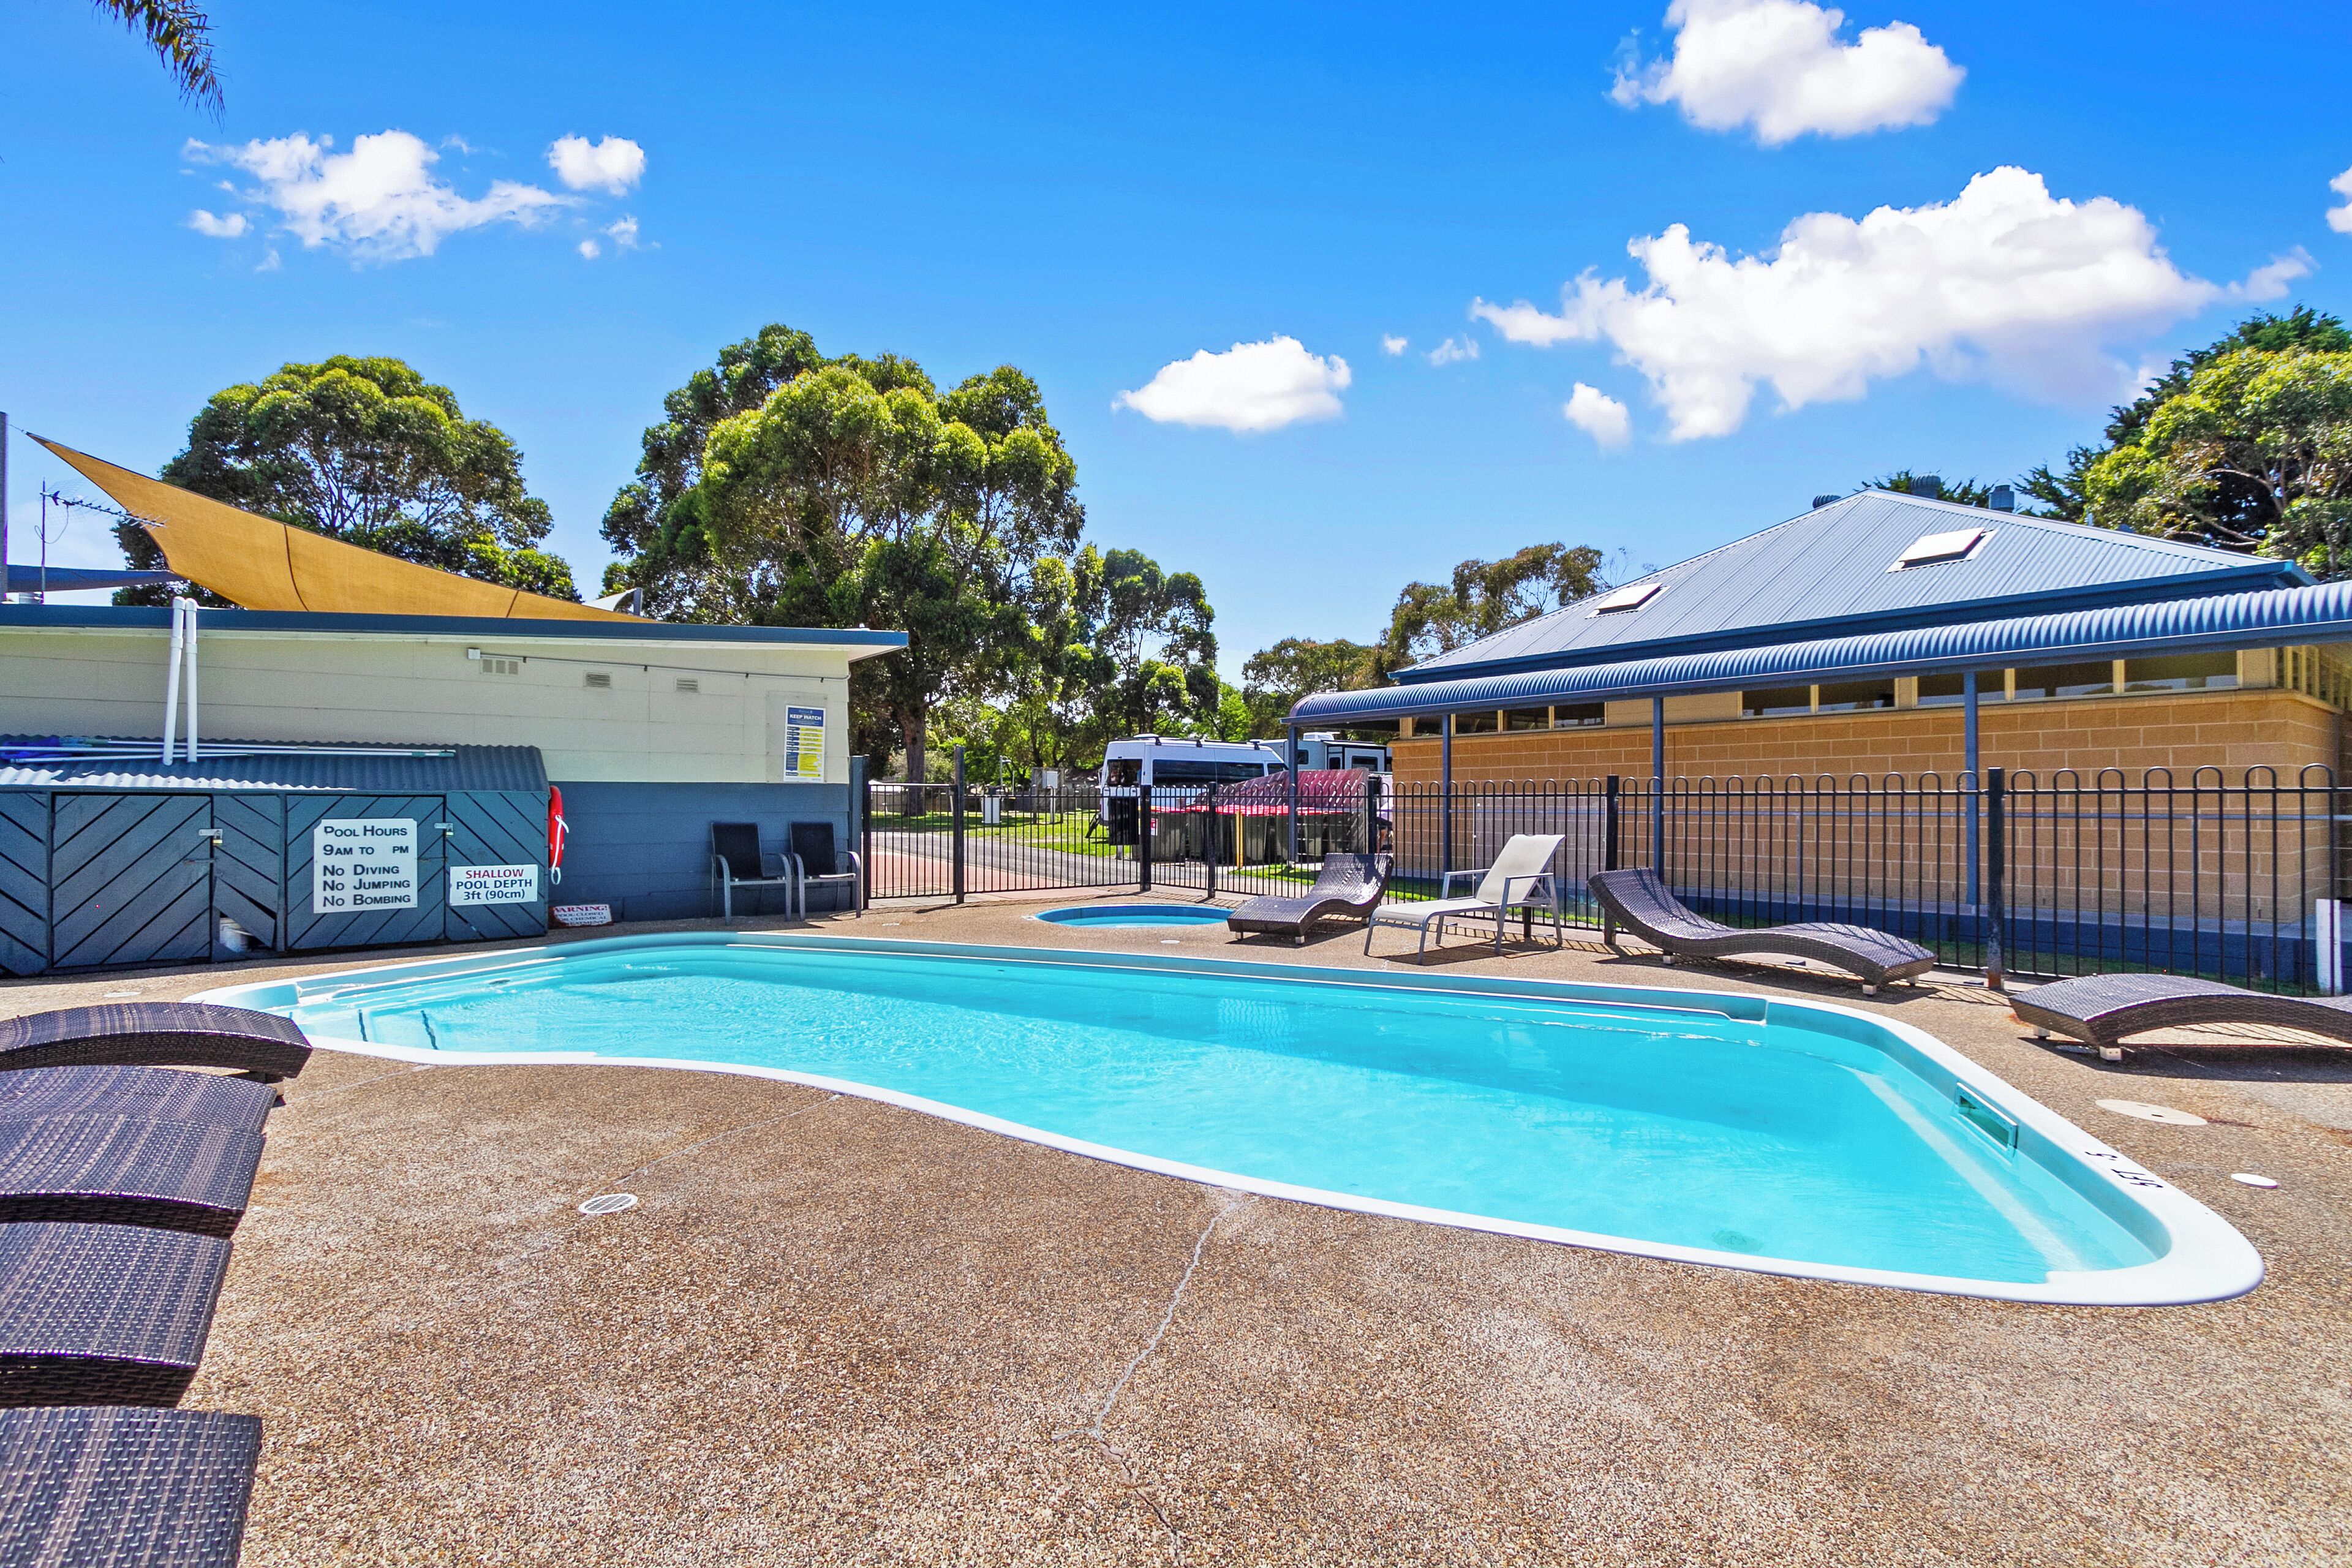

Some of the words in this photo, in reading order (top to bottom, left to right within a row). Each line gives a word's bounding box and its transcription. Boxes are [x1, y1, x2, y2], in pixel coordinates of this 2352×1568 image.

[324, 826, 360, 837] POOL
[363, 825, 408, 836] HOURS
[323, 844, 353, 856] 9AM
[358, 846, 375, 855] TO
[392, 845, 409, 854] PM
[353, 864, 399, 876] DIVING
[466, 869, 524, 879] SHALLOW
[353, 878, 410, 890] JUMPING
[456, 880, 490, 890] POOL
[494, 878, 532, 889] DEPTH
[353, 894, 411, 905] BOMBING
[463, 891, 481, 900] 3ft
[485, 889, 525, 901] (90cm)
